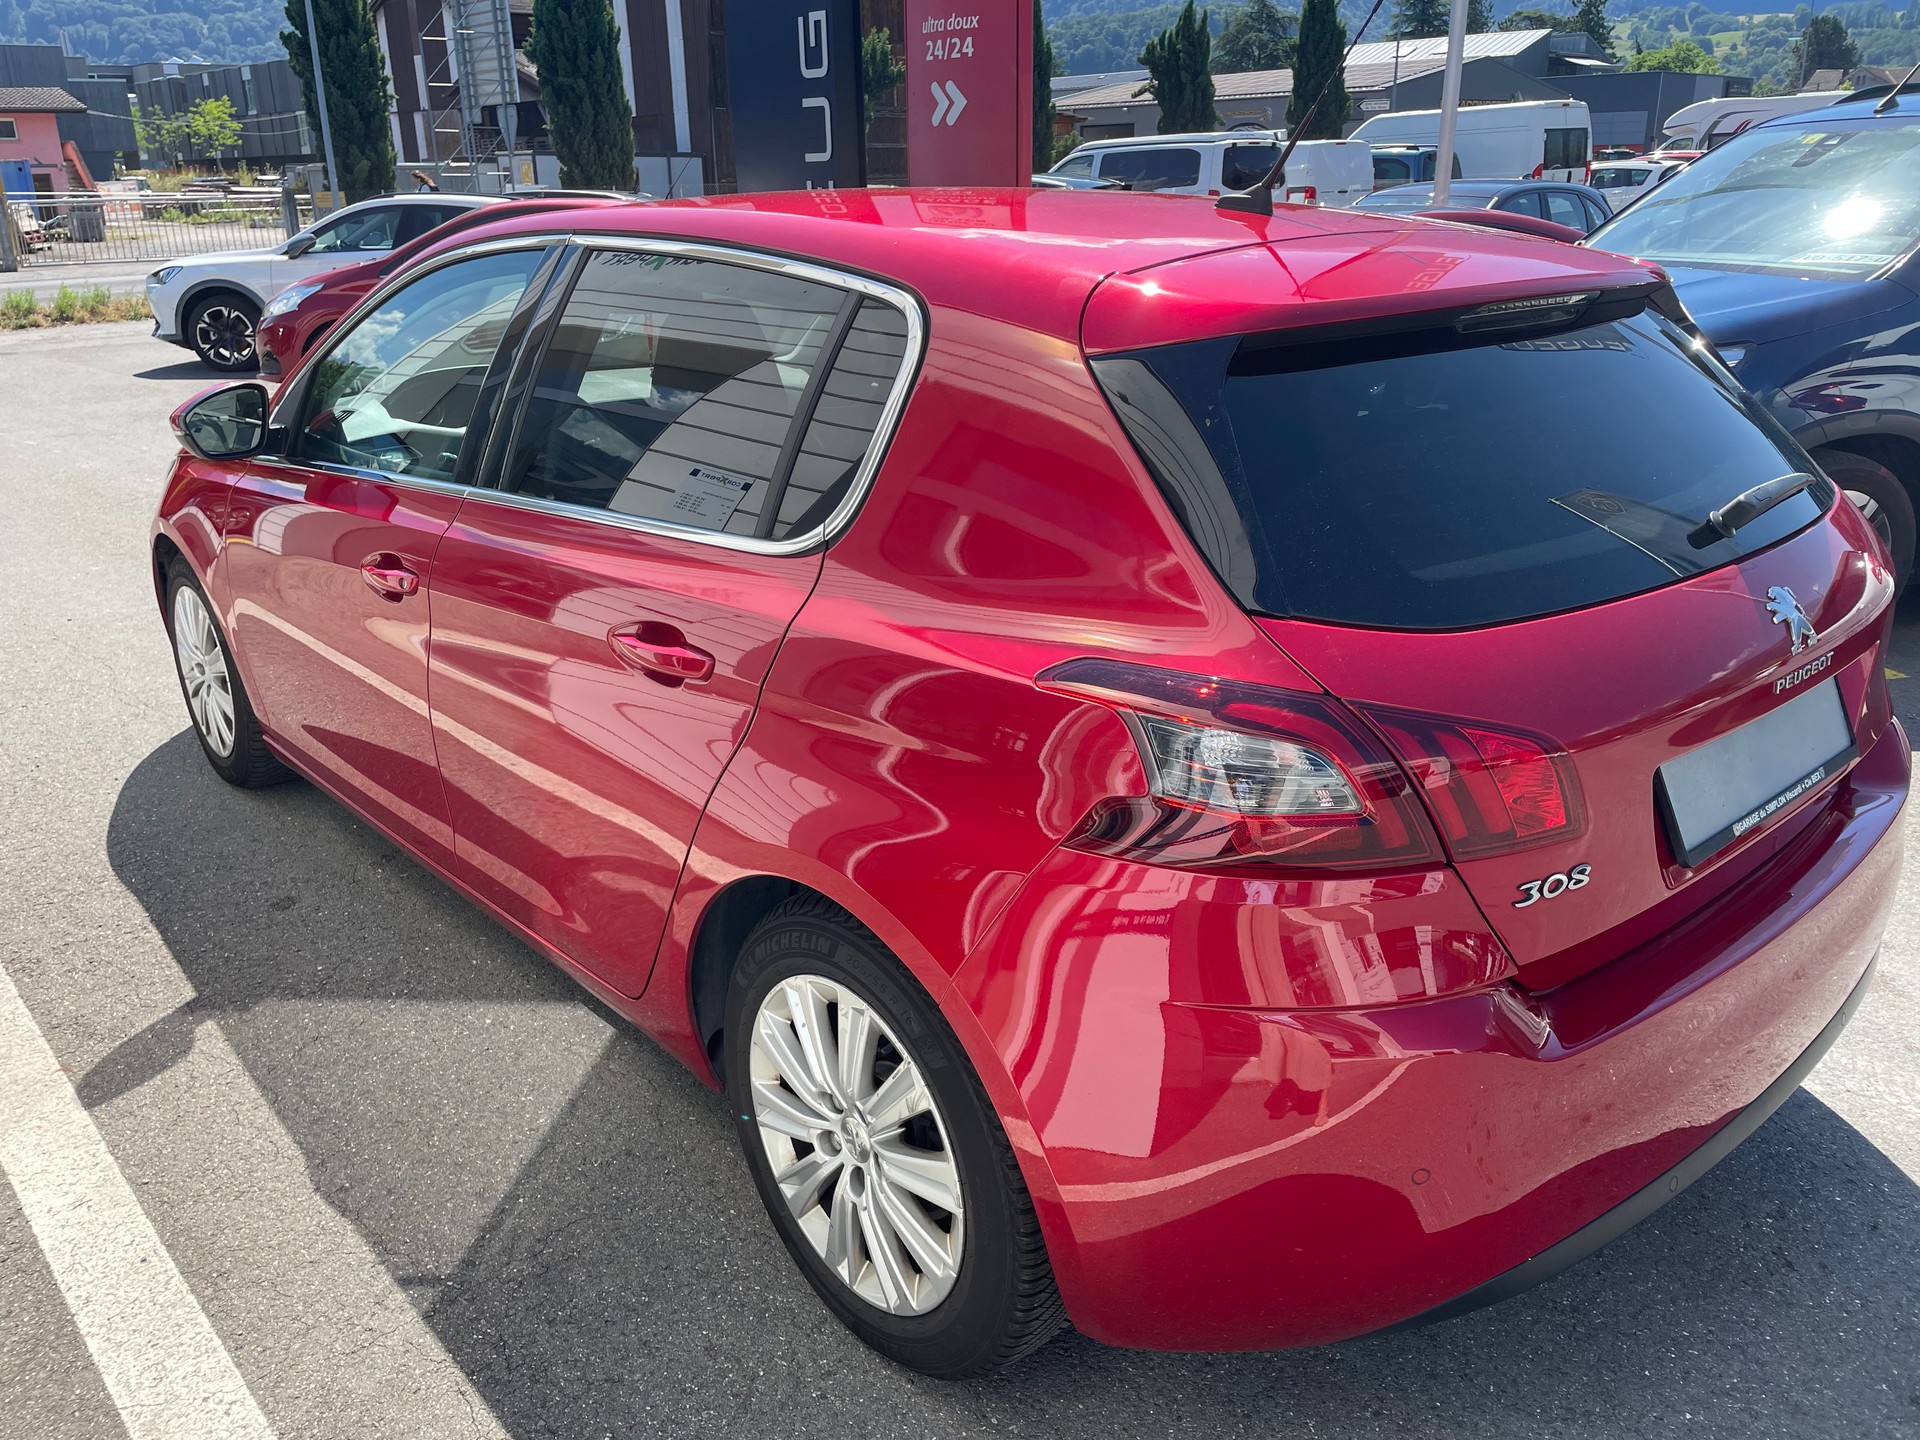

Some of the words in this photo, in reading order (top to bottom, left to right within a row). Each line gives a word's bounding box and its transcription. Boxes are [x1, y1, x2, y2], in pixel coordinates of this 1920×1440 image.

[922, 15, 945, 34] ultra
[946, 12, 980, 31] doux
[926, 36, 975, 61] 24/24
[1773, 651, 1835, 695] PEUGEOT
[1739, 812, 1760, 830] GARAGE
[1759, 809, 1767, 819] du
[1765, 795, 1786, 814] SIMPLON
[1810, 771, 1821, 783] BEX
[1511, 862, 1592, 908] 308
[754, 931, 832, 963] MICHELIN
[844, 954, 886, 994] 205/55
